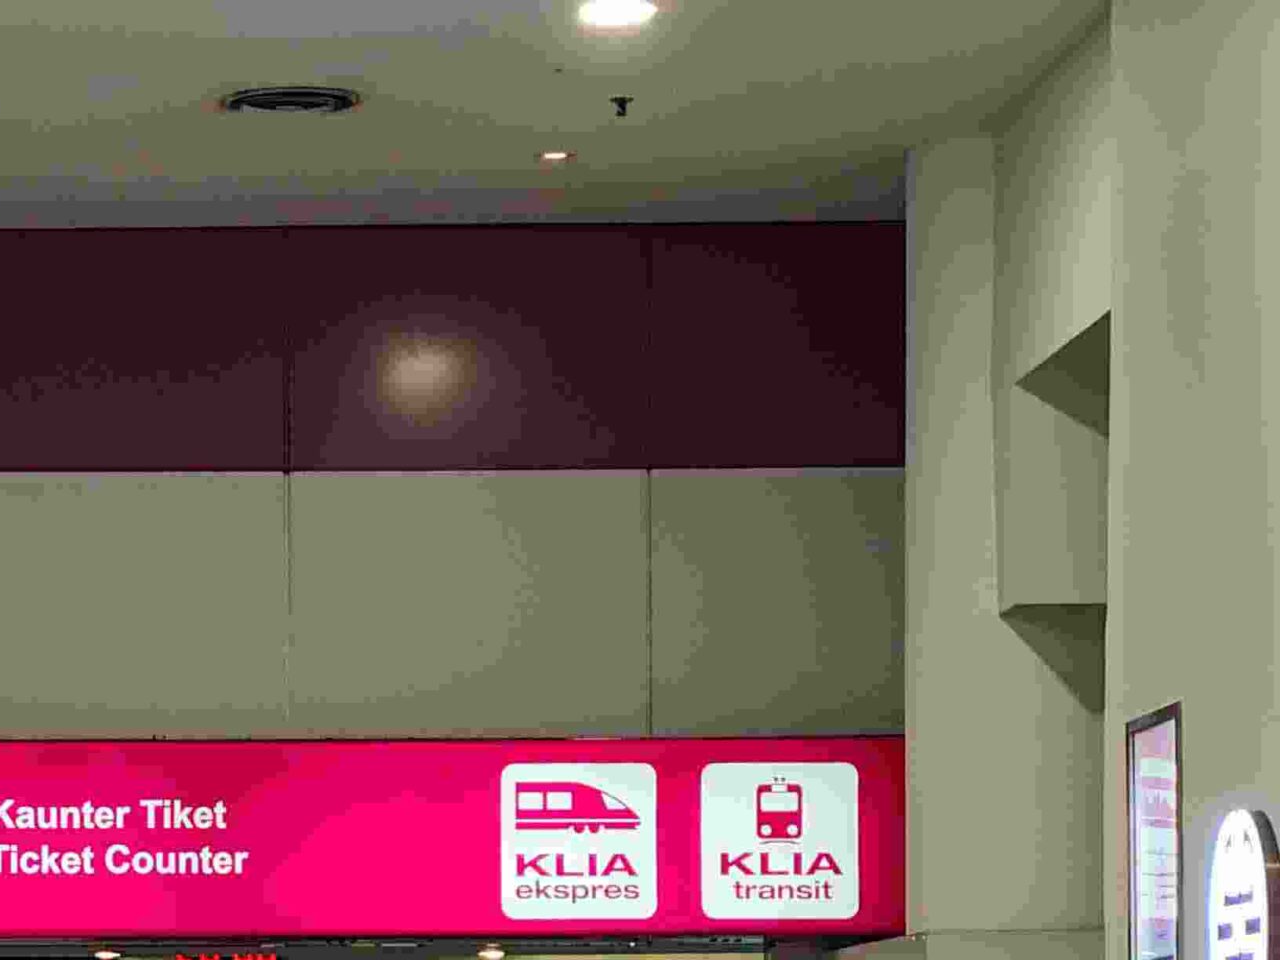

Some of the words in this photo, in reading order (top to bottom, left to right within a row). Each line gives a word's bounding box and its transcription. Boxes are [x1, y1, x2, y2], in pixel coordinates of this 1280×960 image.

[140, 800, 227, 829] Tiket
[105, 844, 248, 874] Counter
[516, 853, 637, 876] KLIA
[720, 852, 842, 875] KLIA
[515, 879, 640, 903] ekspres
[733, 880, 832, 900] transit
